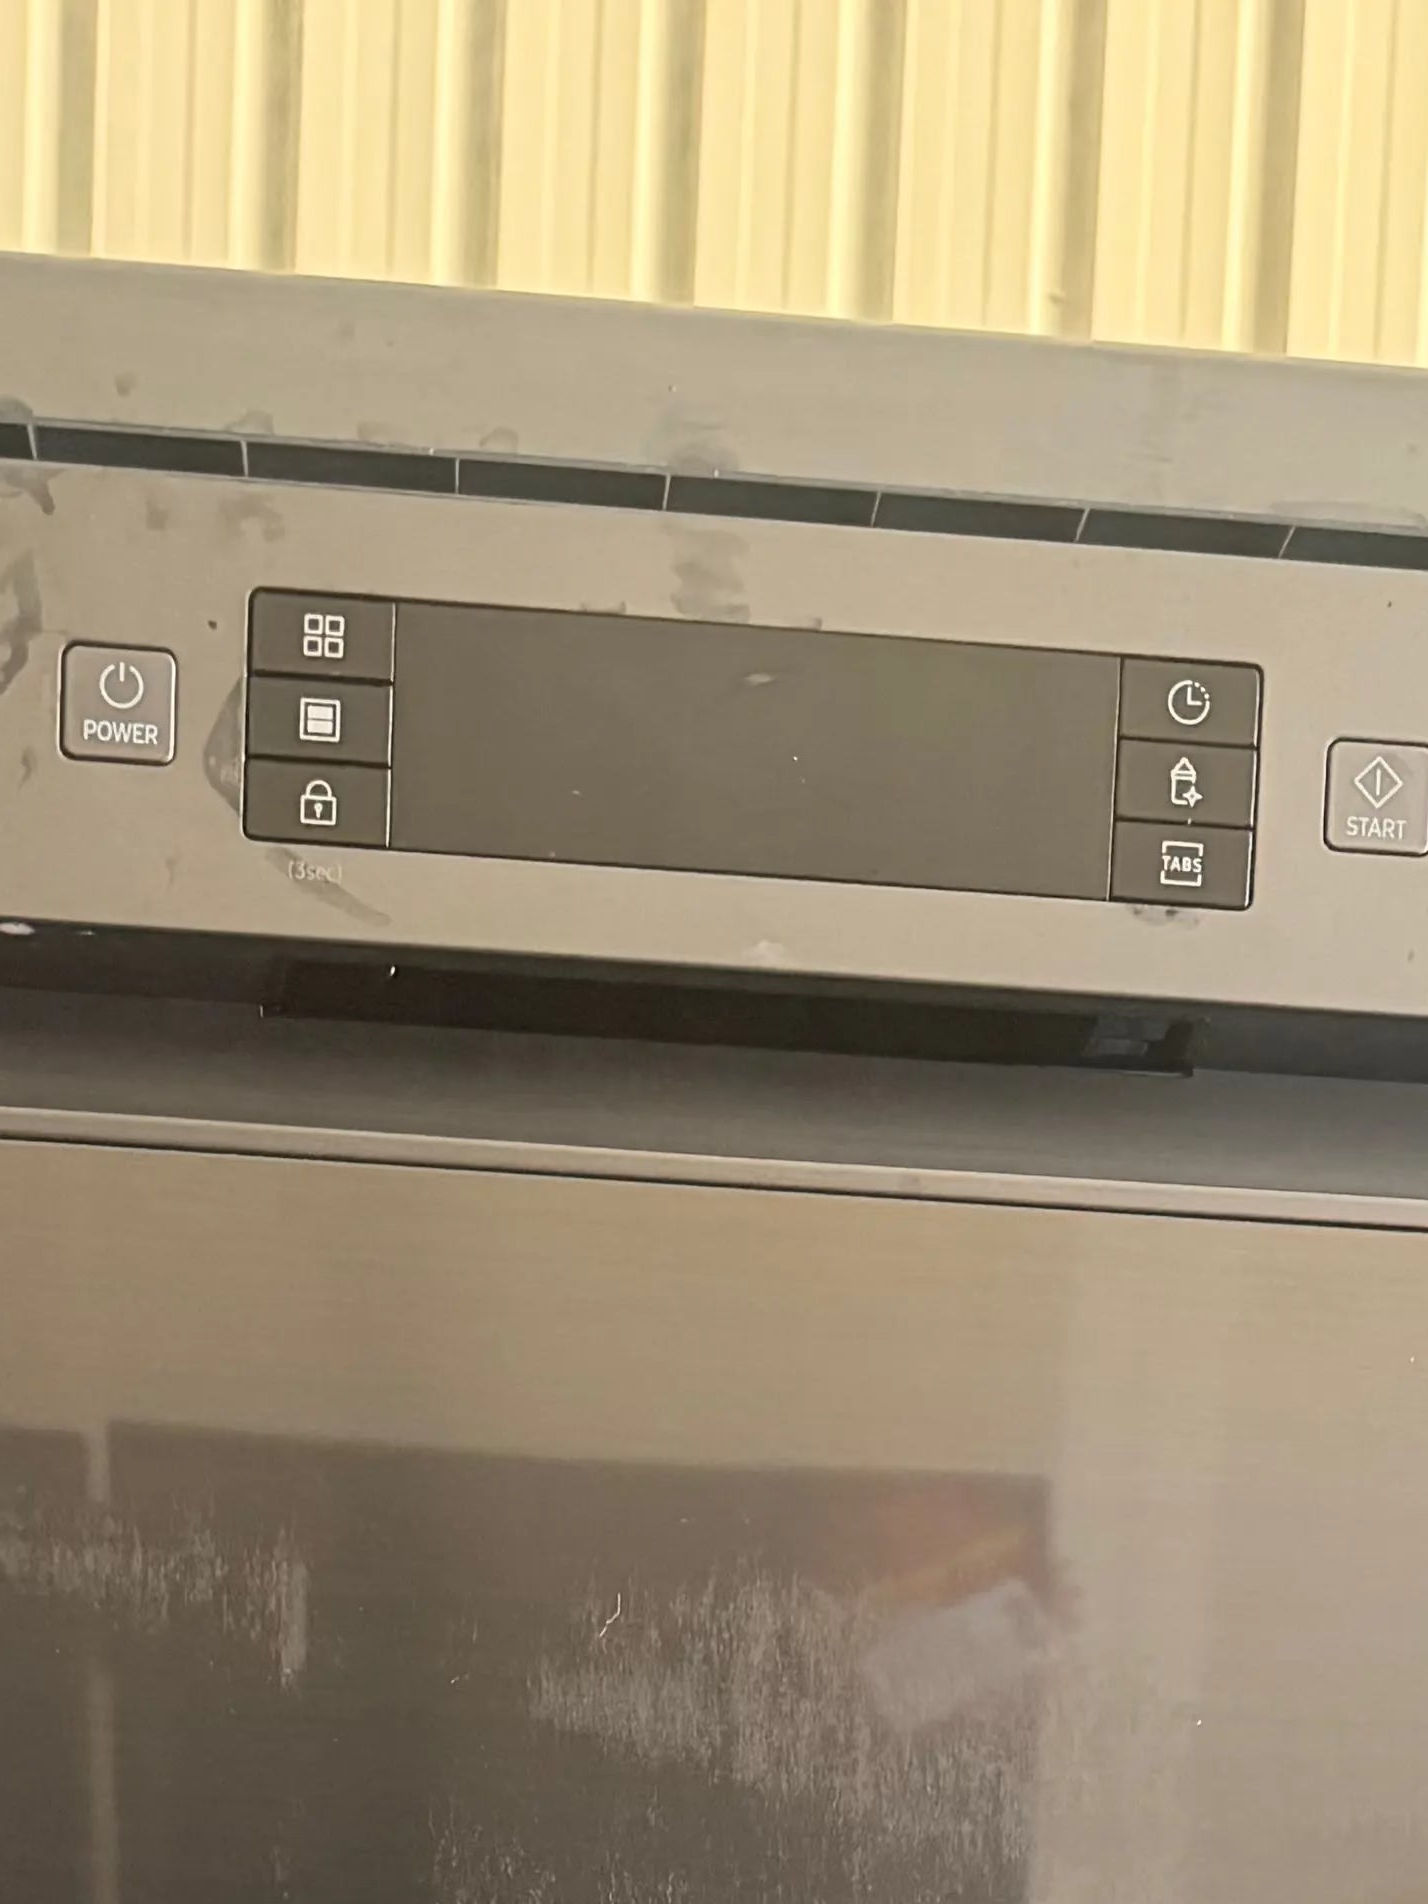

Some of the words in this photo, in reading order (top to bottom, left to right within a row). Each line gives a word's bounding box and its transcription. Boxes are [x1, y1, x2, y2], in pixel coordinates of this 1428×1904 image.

[83, 719, 159, 745] POWER
[1345, 815, 1407, 841] START
[287, 859, 344, 885] (3sec)
[1161, 854, 1203, 873] TABS
